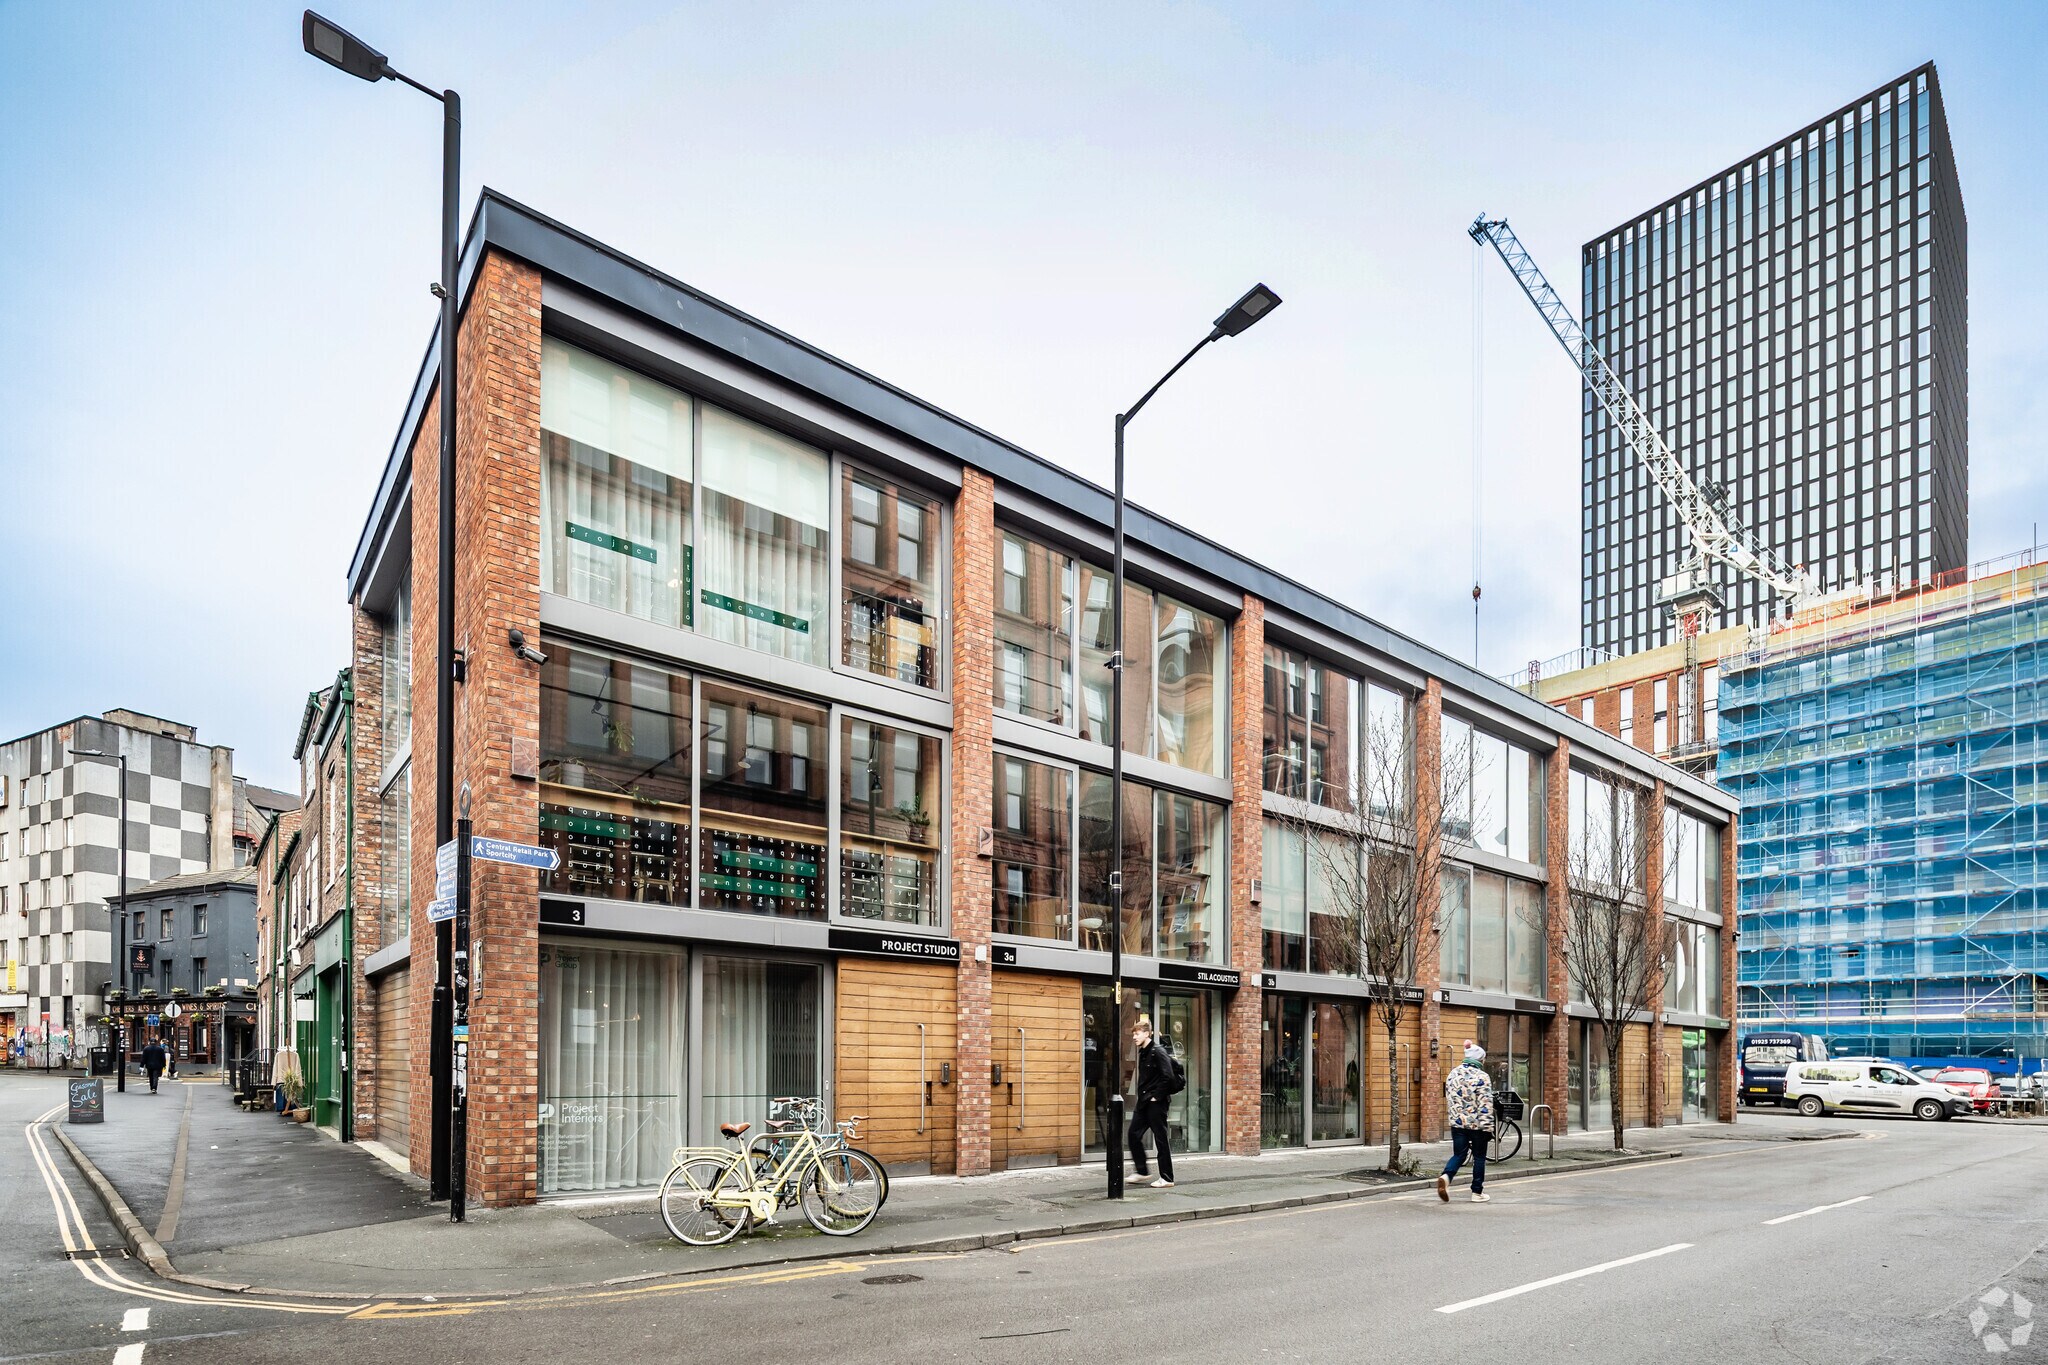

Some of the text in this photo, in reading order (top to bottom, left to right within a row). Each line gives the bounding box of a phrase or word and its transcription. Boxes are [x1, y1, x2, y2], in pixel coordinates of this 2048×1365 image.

[570, 527, 653, 559] project
[701, 593, 806, 630] manchester
[486, 842, 549, 858] Central Retail Park
[486, 849, 517, 860] Sportcity
[572, 910, 581, 921] 3
[882, 939, 957, 956] PROJECT STUDIO
[555, 953, 580, 963] Project
[1004, 952, 1014, 962] 3a
[555, 960, 578, 970] Group
[1197, 972, 1239, 984] STIL ACOUSTICS
[1267, 978, 1275, 986] 3b
[182, 1002, 198, 1011] WINES
[206, 1002, 226, 1011] SPIRITS
[70, 1078, 98, 1092] Seasonal
[71, 1088, 98, 1108] Sale
[561, 1102, 599, 1115] Project
[561, 1113, 604, 1124] Interiors
